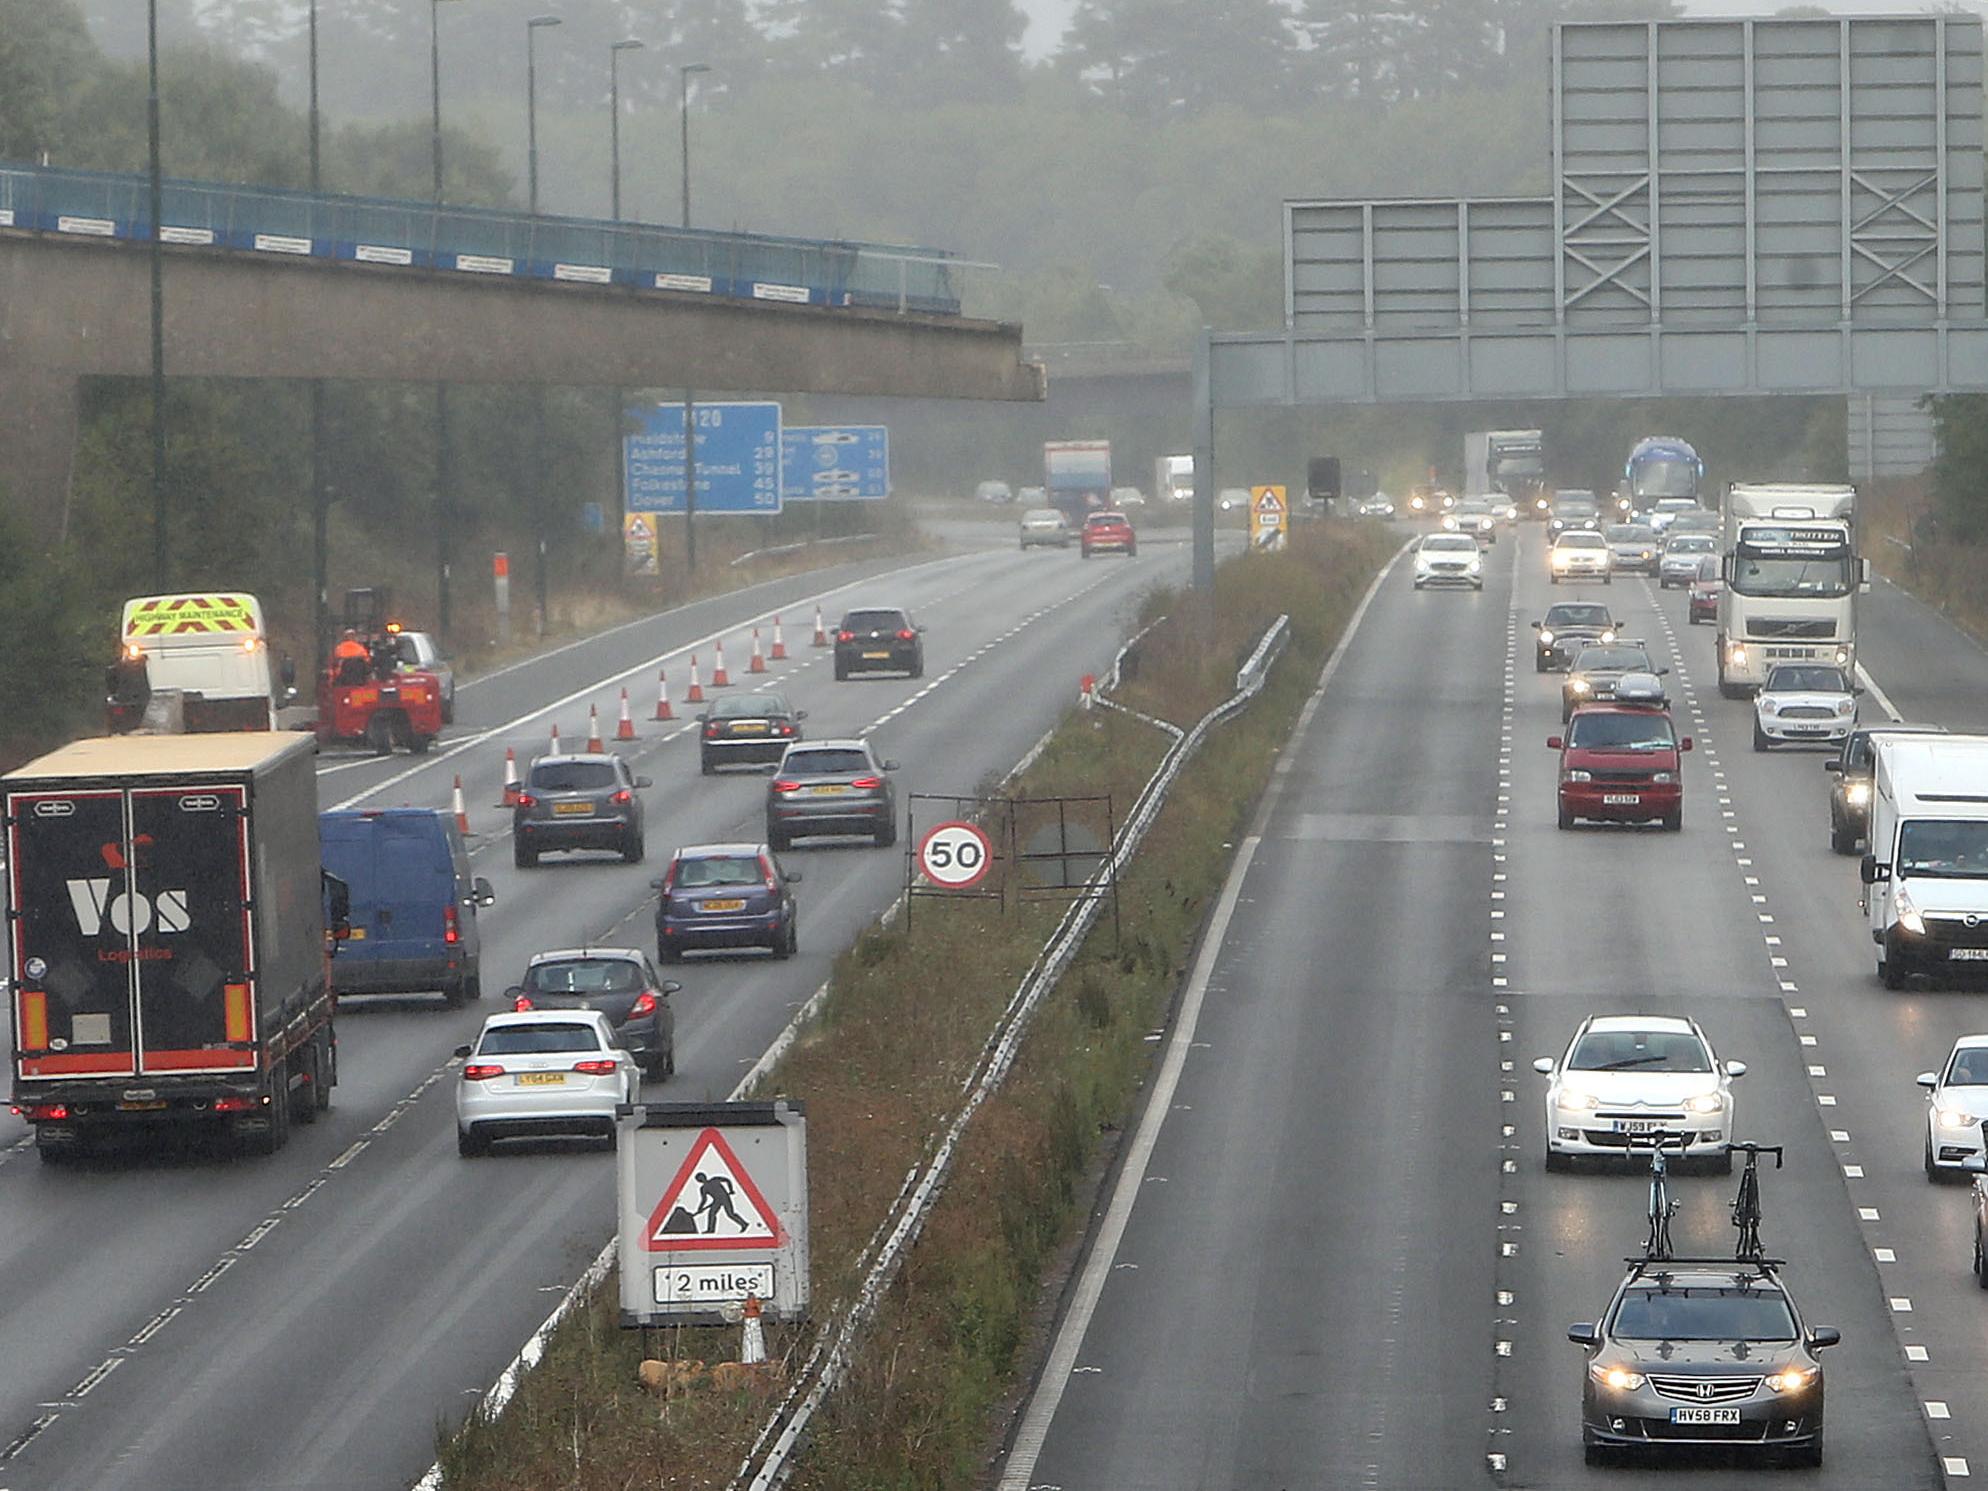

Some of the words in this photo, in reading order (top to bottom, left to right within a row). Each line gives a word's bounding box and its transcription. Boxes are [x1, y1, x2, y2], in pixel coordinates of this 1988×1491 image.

[135, 612, 178, 622] HIGHWAY
[178, 608, 243, 620] MAINTENANCE
[931, 841, 981, 869] 50
[677, 1273, 691, 1292] 2
[699, 1272, 759, 1291] miles
[1678, 1409, 1711, 1422] HV58
[1713, 1410, 1738, 1422] FRX
